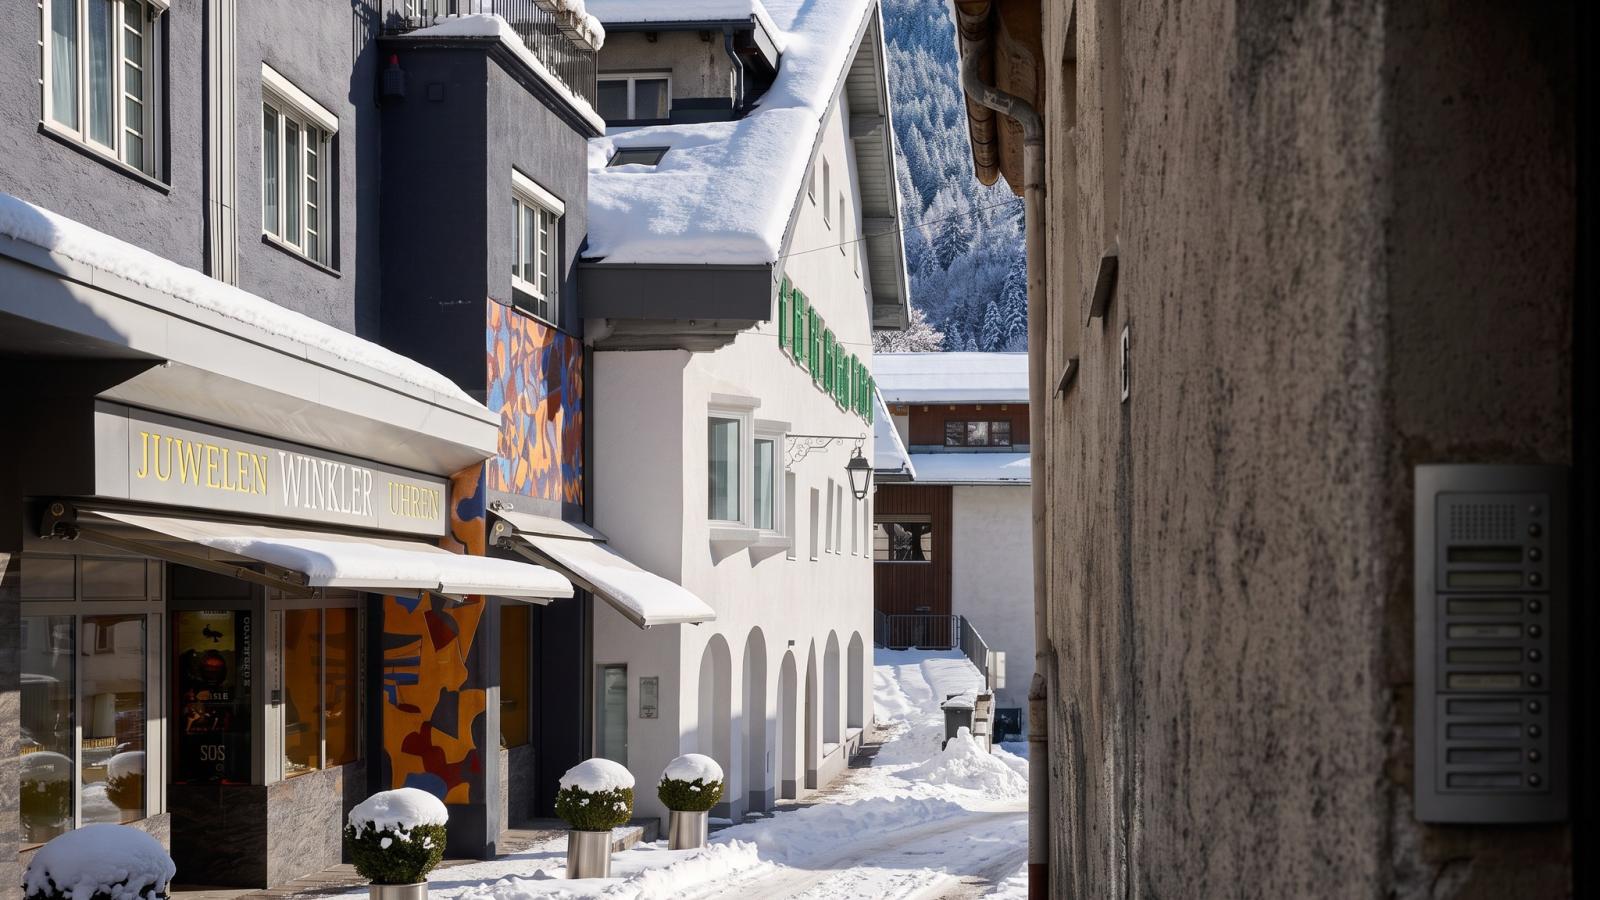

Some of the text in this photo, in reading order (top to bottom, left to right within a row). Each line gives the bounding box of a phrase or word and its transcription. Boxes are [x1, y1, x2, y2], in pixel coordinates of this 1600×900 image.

[136, 431, 440, 521] JUWELEN WINKLER UHREN
[200, 744, 226, 761] SOS
